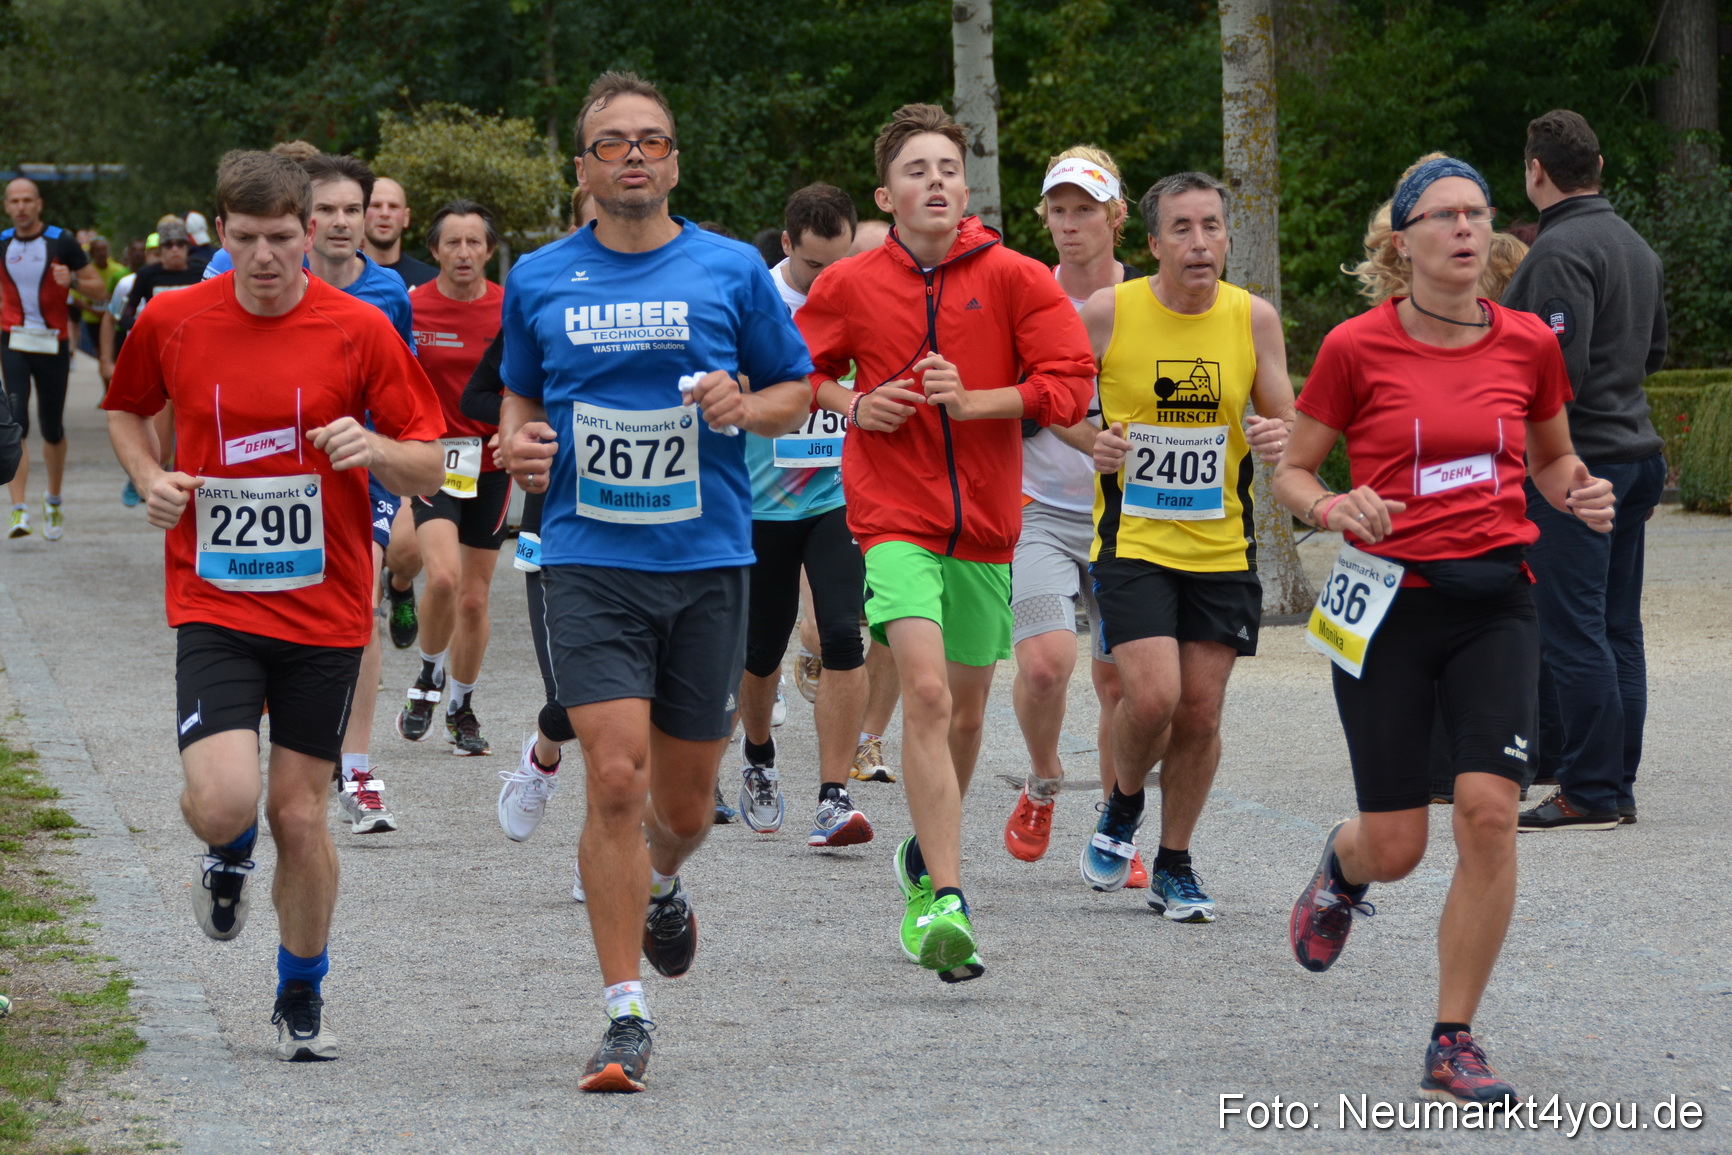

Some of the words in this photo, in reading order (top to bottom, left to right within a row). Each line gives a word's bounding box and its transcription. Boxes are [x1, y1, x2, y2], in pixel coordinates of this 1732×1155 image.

[565, 300, 689, 332] HUBER
[591, 327, 685, 341] TECHNOLOGY
[592, 343, 622, 354] WASTE
[622, 341, 651, 352] WATER
[652, 341, 686, 351] Solutions
[576, 413, 613, 432] PARTL
[615, 420, 676, 433] Neumarkt
[788, 409, 848, 435] 75
[1156, 410, 1218, 424] HIRSCH
[245, 438, 276, 454] DEHN
[1129, 431, 1162, 445] PARTL
[1165, 436, 1213, 446] Neumarkt
[585, 433, 686, 480] 2672
[807, 443, 833, 457] Jörg
[1135, 447, 1218, 485] 2403
[1441, 464, 1473, 483] DEHN
[198, 487, 238, 500] PARTL
[240, 488, 300, 500] Neumarkt
[600, 488, 672, 508] Matthias
[1156, 492, 1194, 507] Franz
[376, 500, 394, 515] 35
[210, 503, 312, 547] 2290
[227, 558, 295, 575] Andreas
[1318, 619, 1344, 651] Monika
